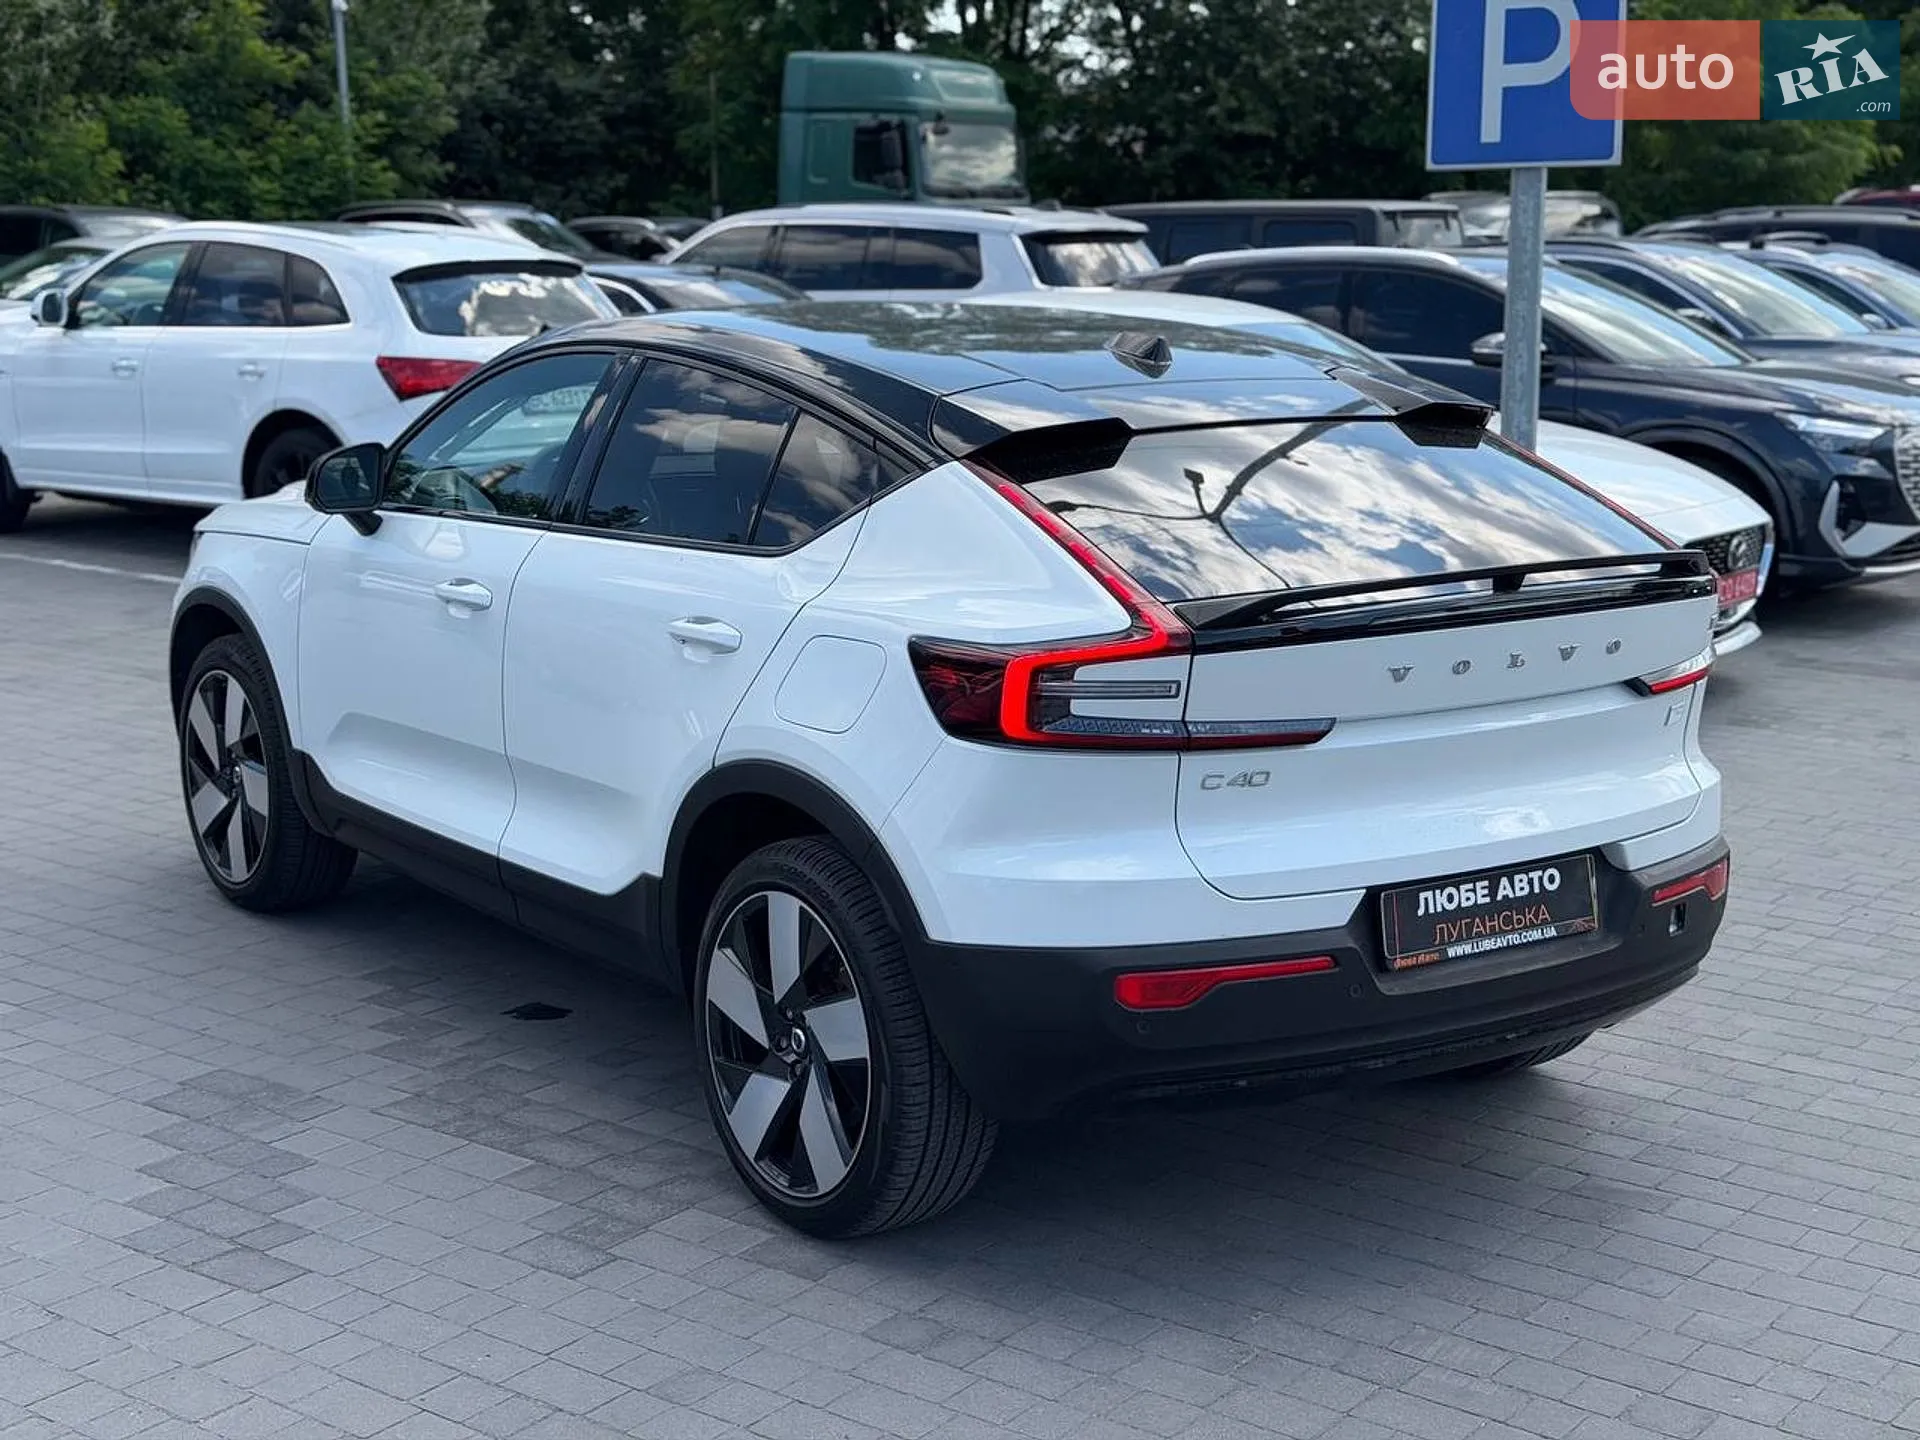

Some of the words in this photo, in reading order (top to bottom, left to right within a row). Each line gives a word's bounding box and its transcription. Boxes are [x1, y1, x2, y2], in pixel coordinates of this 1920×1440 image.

[1480, 0, 1581, 143] P
[1387, 638, 1623, 684] VOLVO
[1417, 881, 1490, 917] ЛЮБЕ
[1496, 867, 1562, 902] АВТО
[1434, 904, 1551, 946] ЛУГАНСЬКА
[1446, 925, 1558, 959] WWW.LUBEAVTO.COM.UA
